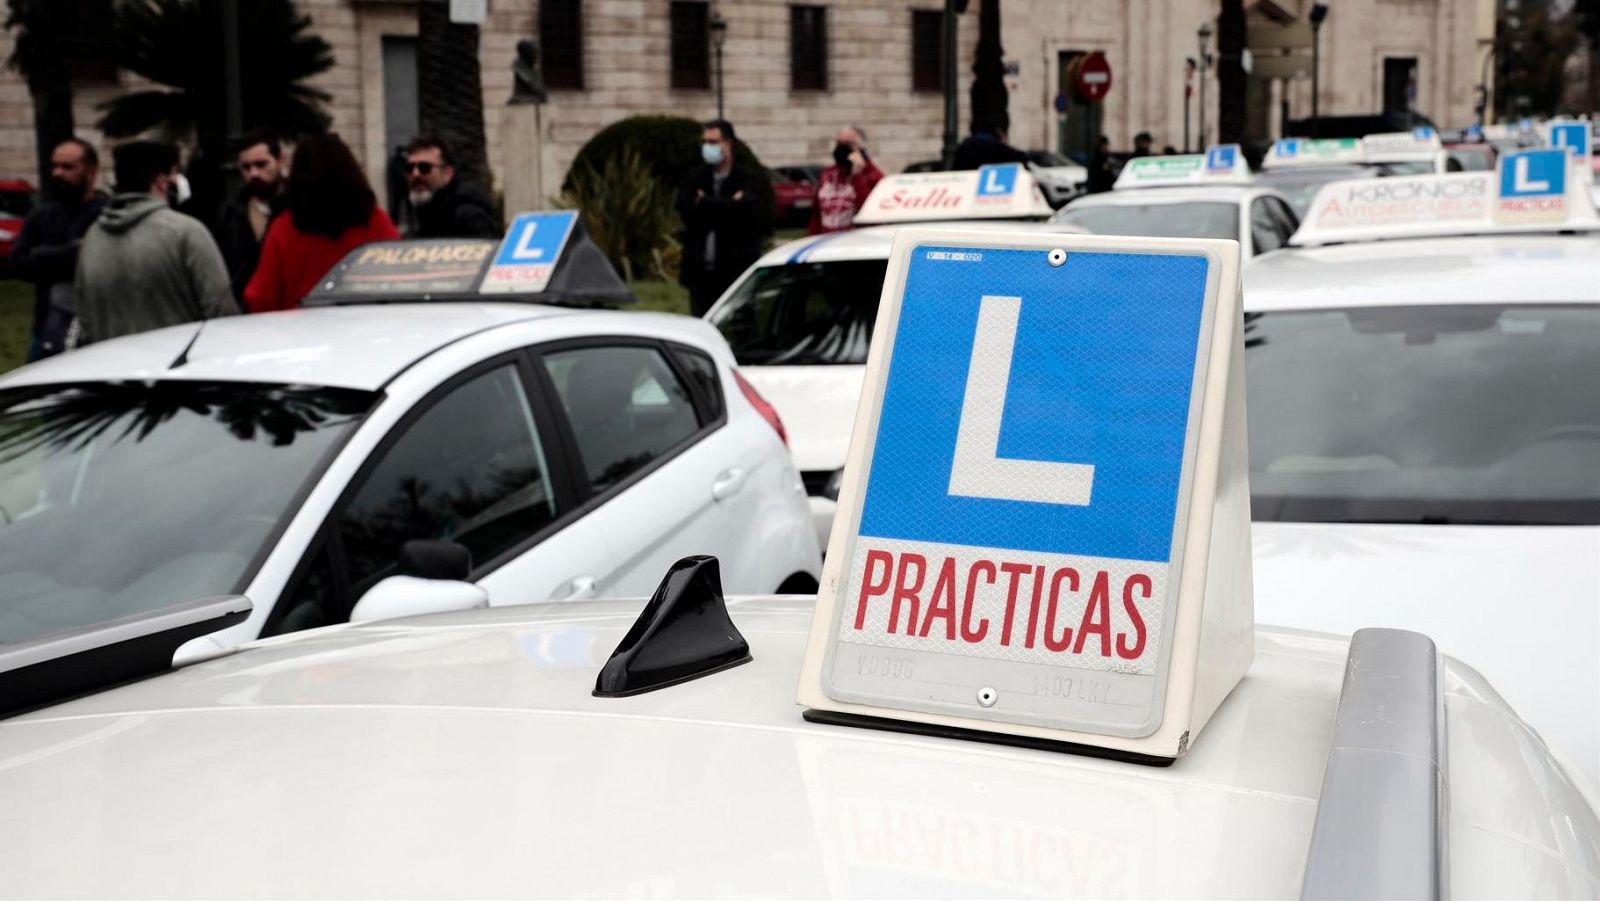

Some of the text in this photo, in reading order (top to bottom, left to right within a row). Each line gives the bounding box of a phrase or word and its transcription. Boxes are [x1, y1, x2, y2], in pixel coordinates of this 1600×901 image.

[985, 170, 1006, 192] L
[1515, 156, 1550, 193] L
[880, 187, 963, 210] Salla
[512, 222, 544, 260] L
[948, 295, 1096, 507] L
[854, 549, 1153, 660] PRACTICAS
